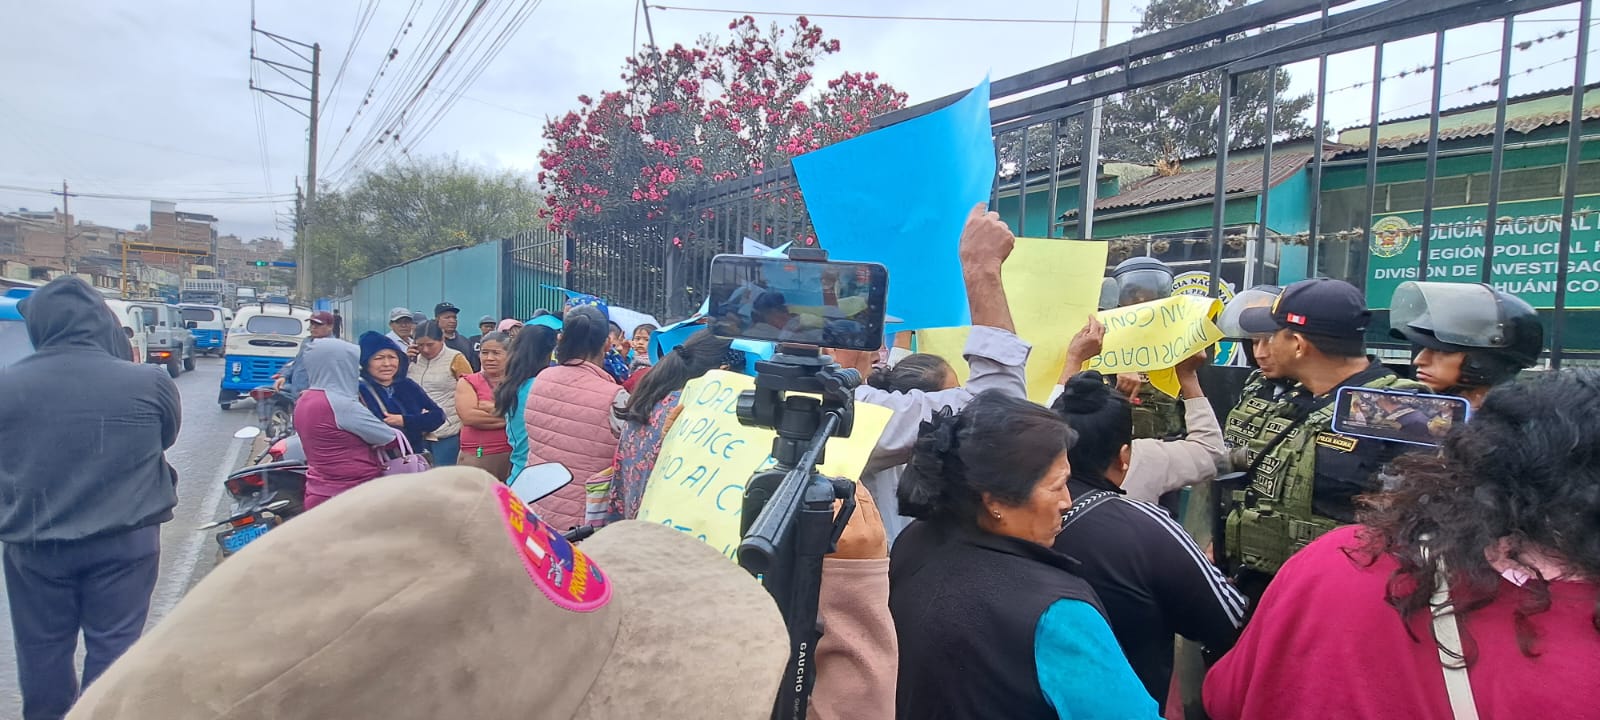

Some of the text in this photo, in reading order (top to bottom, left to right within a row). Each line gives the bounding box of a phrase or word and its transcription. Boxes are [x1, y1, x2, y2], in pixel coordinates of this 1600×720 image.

[1452, 265, 1477, 277] DE
[1491, 259, 1600, 275] NVESTIGAC
[794, 642, 807, 693] GAUCHO
